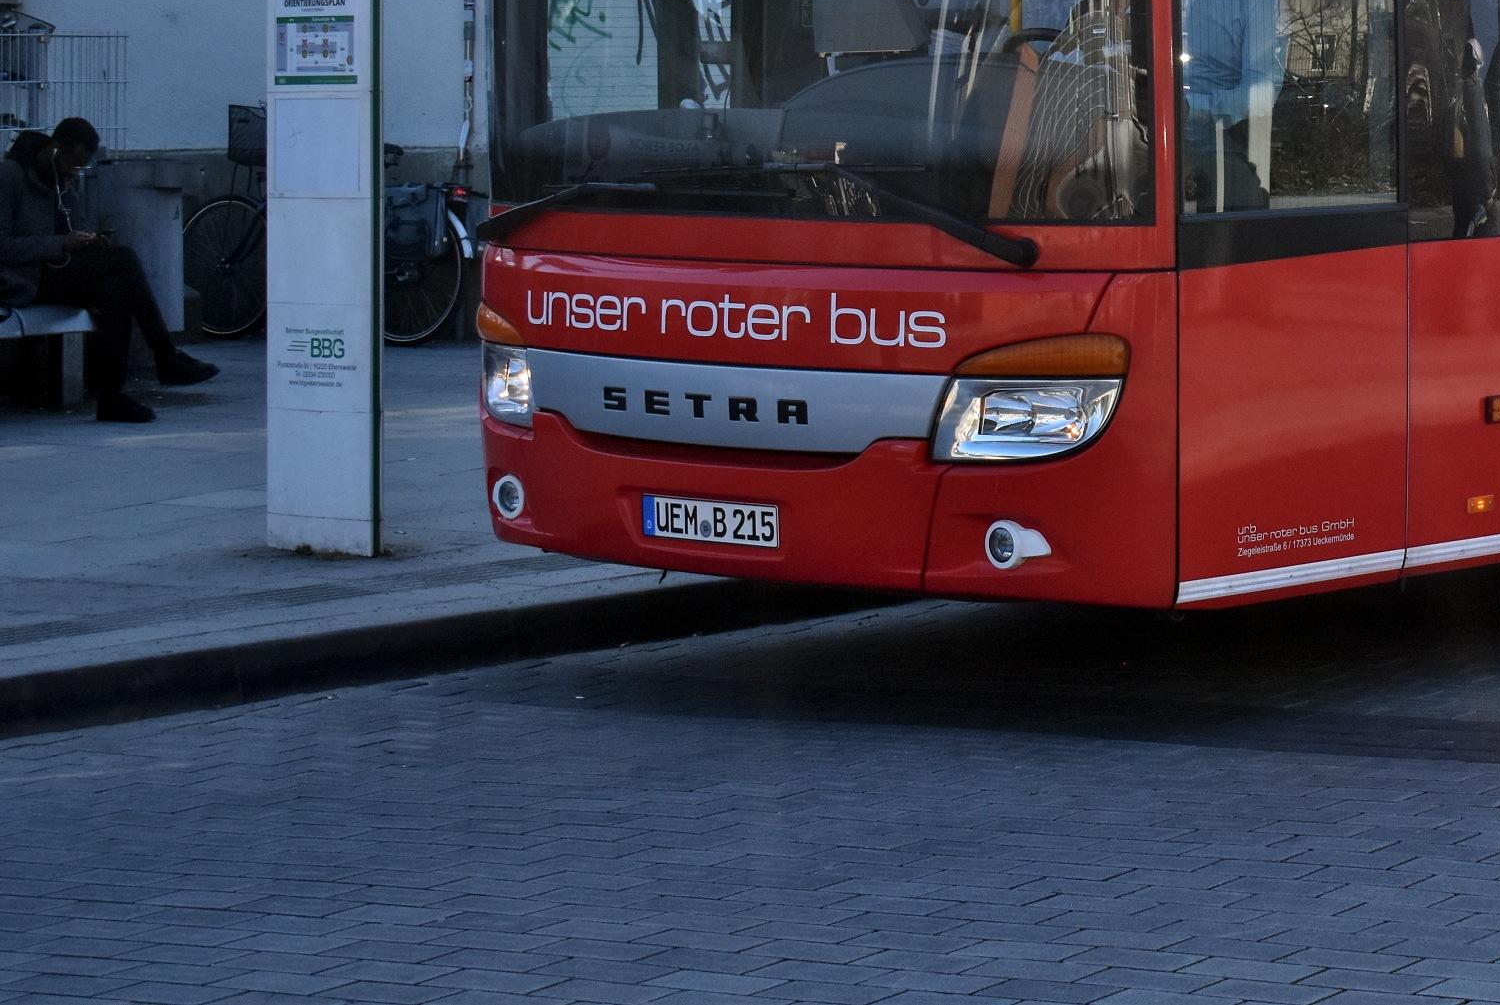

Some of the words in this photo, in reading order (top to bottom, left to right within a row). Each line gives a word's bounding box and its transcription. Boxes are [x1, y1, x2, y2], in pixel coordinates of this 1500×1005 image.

[527, 290, 646, 331] unser
[660, 294, 811, 342] roter
[830, 292, 947, 348] bus
[310, 337, 345, 359] BBG
[603, 386, 809, 426] SETRA
[656, 504, 698, 536] UEM
[712, 506, 728, 538] B
[732, 508, 775, 543] 215
[1237, 524, 1257, 535] urb
[1237, 531, 1268, 544] unser
[1269, 528, 1298, 539] roter
[1299, 524, 1318, 535] bus
[1321, 517, 1355, 532] GmbH
[1237, 541, 1282, 558] Ziegeleistraße
[1282, 541, 1288, 550] 6
[1292, 537, 1312, 549] 17373
[1313, 532, 1355, 546] Ueckermünde
